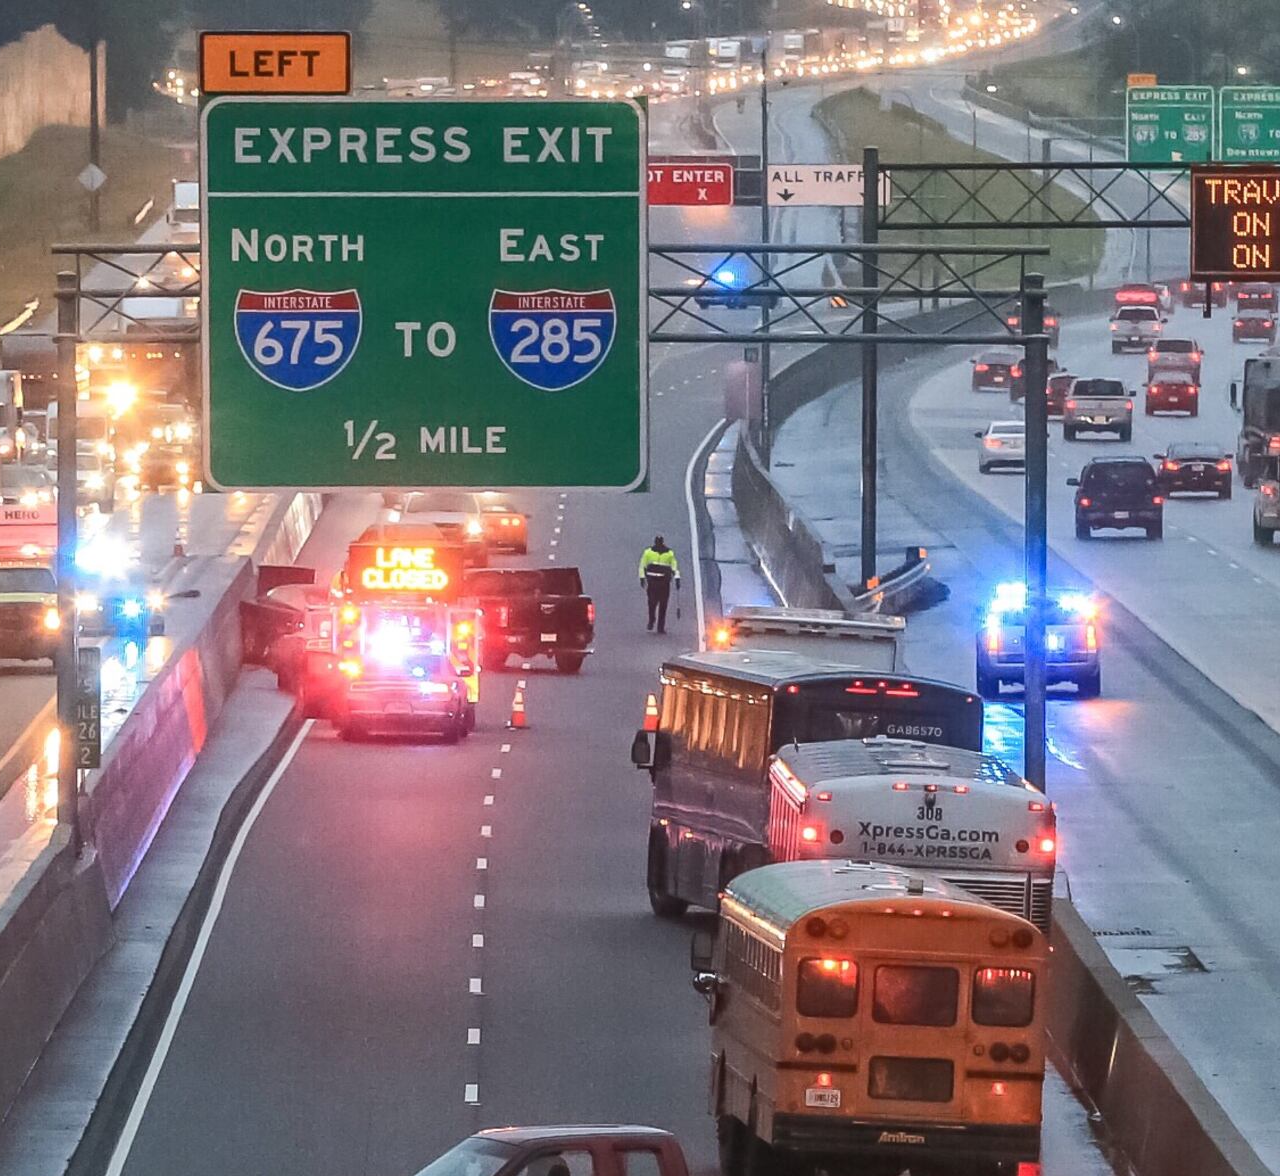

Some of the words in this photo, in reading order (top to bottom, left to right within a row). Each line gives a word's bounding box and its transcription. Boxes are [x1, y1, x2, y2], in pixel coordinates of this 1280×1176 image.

[228, 50, 320, 77] LEFT
[1132, 91, 1180, 101] EXPRESS
[1185, 91, 1209, 101] EXIT
[1233, 92, 1280, 102] EXPRESS
[1164, 130, 1177, 140] TO
[234, 127, 471, 164] EXPRESS
[503, 127, 612, 164] EXIT
[1227, 147, 1280, 157] Downtown
[672, 170, 724, 183] ENTER
[772, 171, 804, 183] ALL
[1232, 211, 1271, 237] ON
[231, 228, 365, 262] NORTH
[499, 228, 605, 262] EAST
[1232, 243, 1271, 269] ON
[263, 296, 333, 309] INTERSTATE
[517, 296, 587, 309] INTERSTATE
[252, 320, 345, 366] 675
[395, 322, 457, 358] TO
[509, 319, 602, 364] 285
[420, 427, 507, 454] MILE
[375, 547, 435, 569] LANE
[362, 567, 448, 590] CLOSED
[77, 704, 97, 719] ILE
[79, 722, 96, 739] 26
[916, 806, 943, 821] 308
[858, 821, 999, 843] XpressGa.com
[862, 841, 993, 861] 1-844-XPRSSGA
